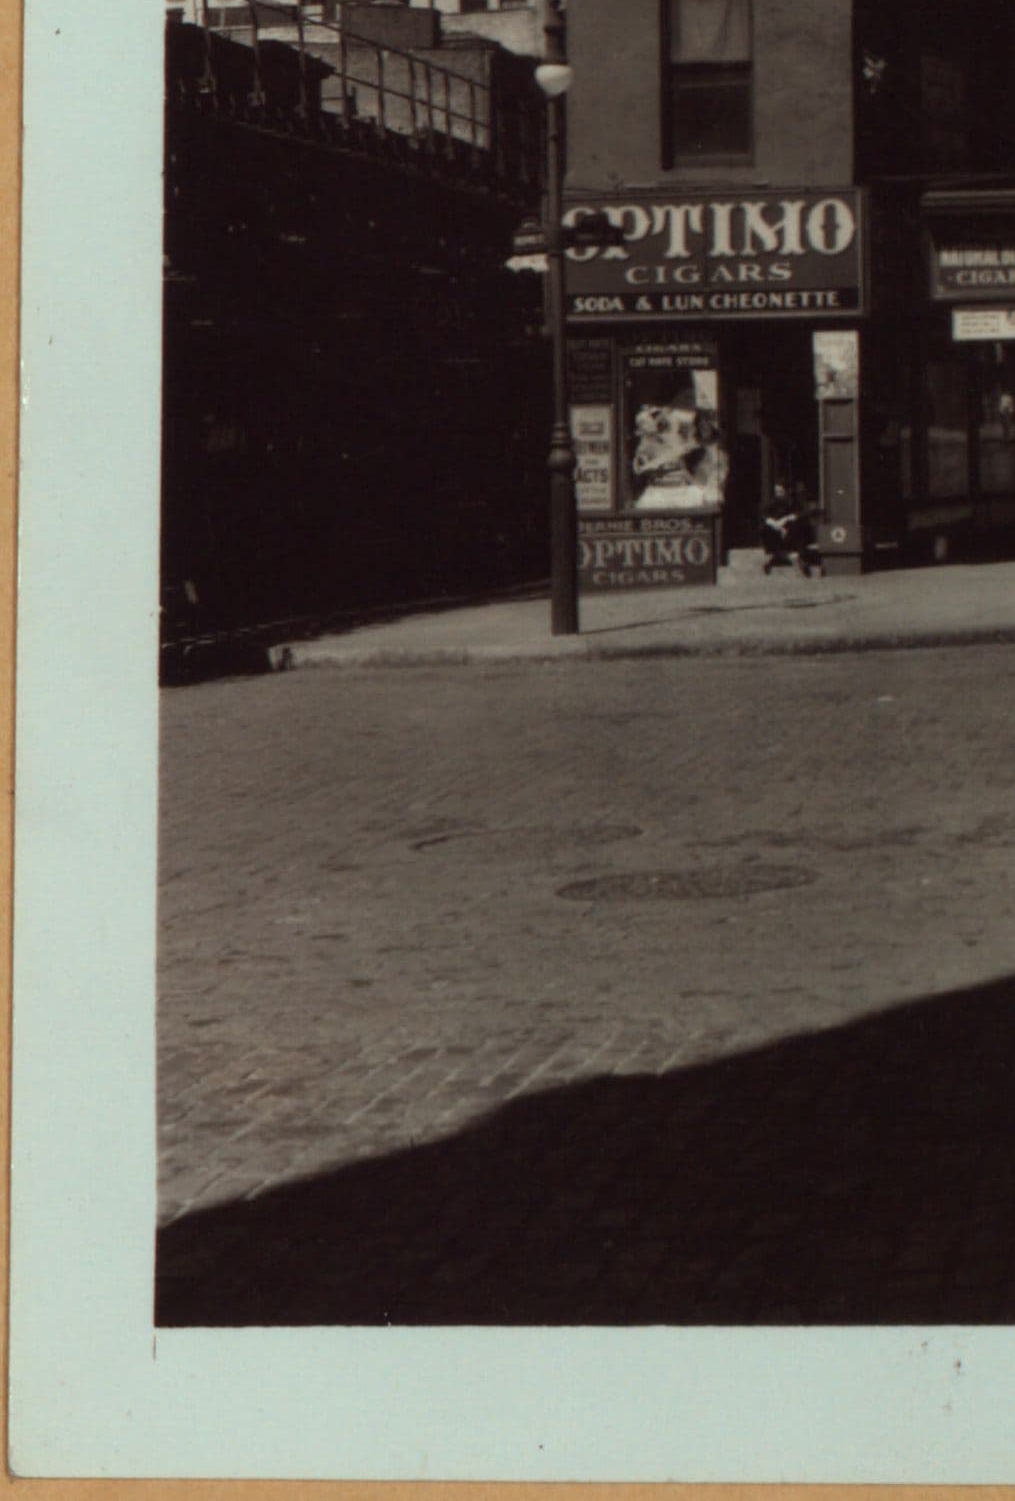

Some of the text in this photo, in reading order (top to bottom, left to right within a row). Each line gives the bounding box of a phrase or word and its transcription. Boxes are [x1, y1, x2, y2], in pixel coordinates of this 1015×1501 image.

[625, 261, 793, 285] CIGARS
[574, 296, 625, 313] SODA
[635, 296, 652, 311] &
[593, 569, 686, 584] CIGARS
